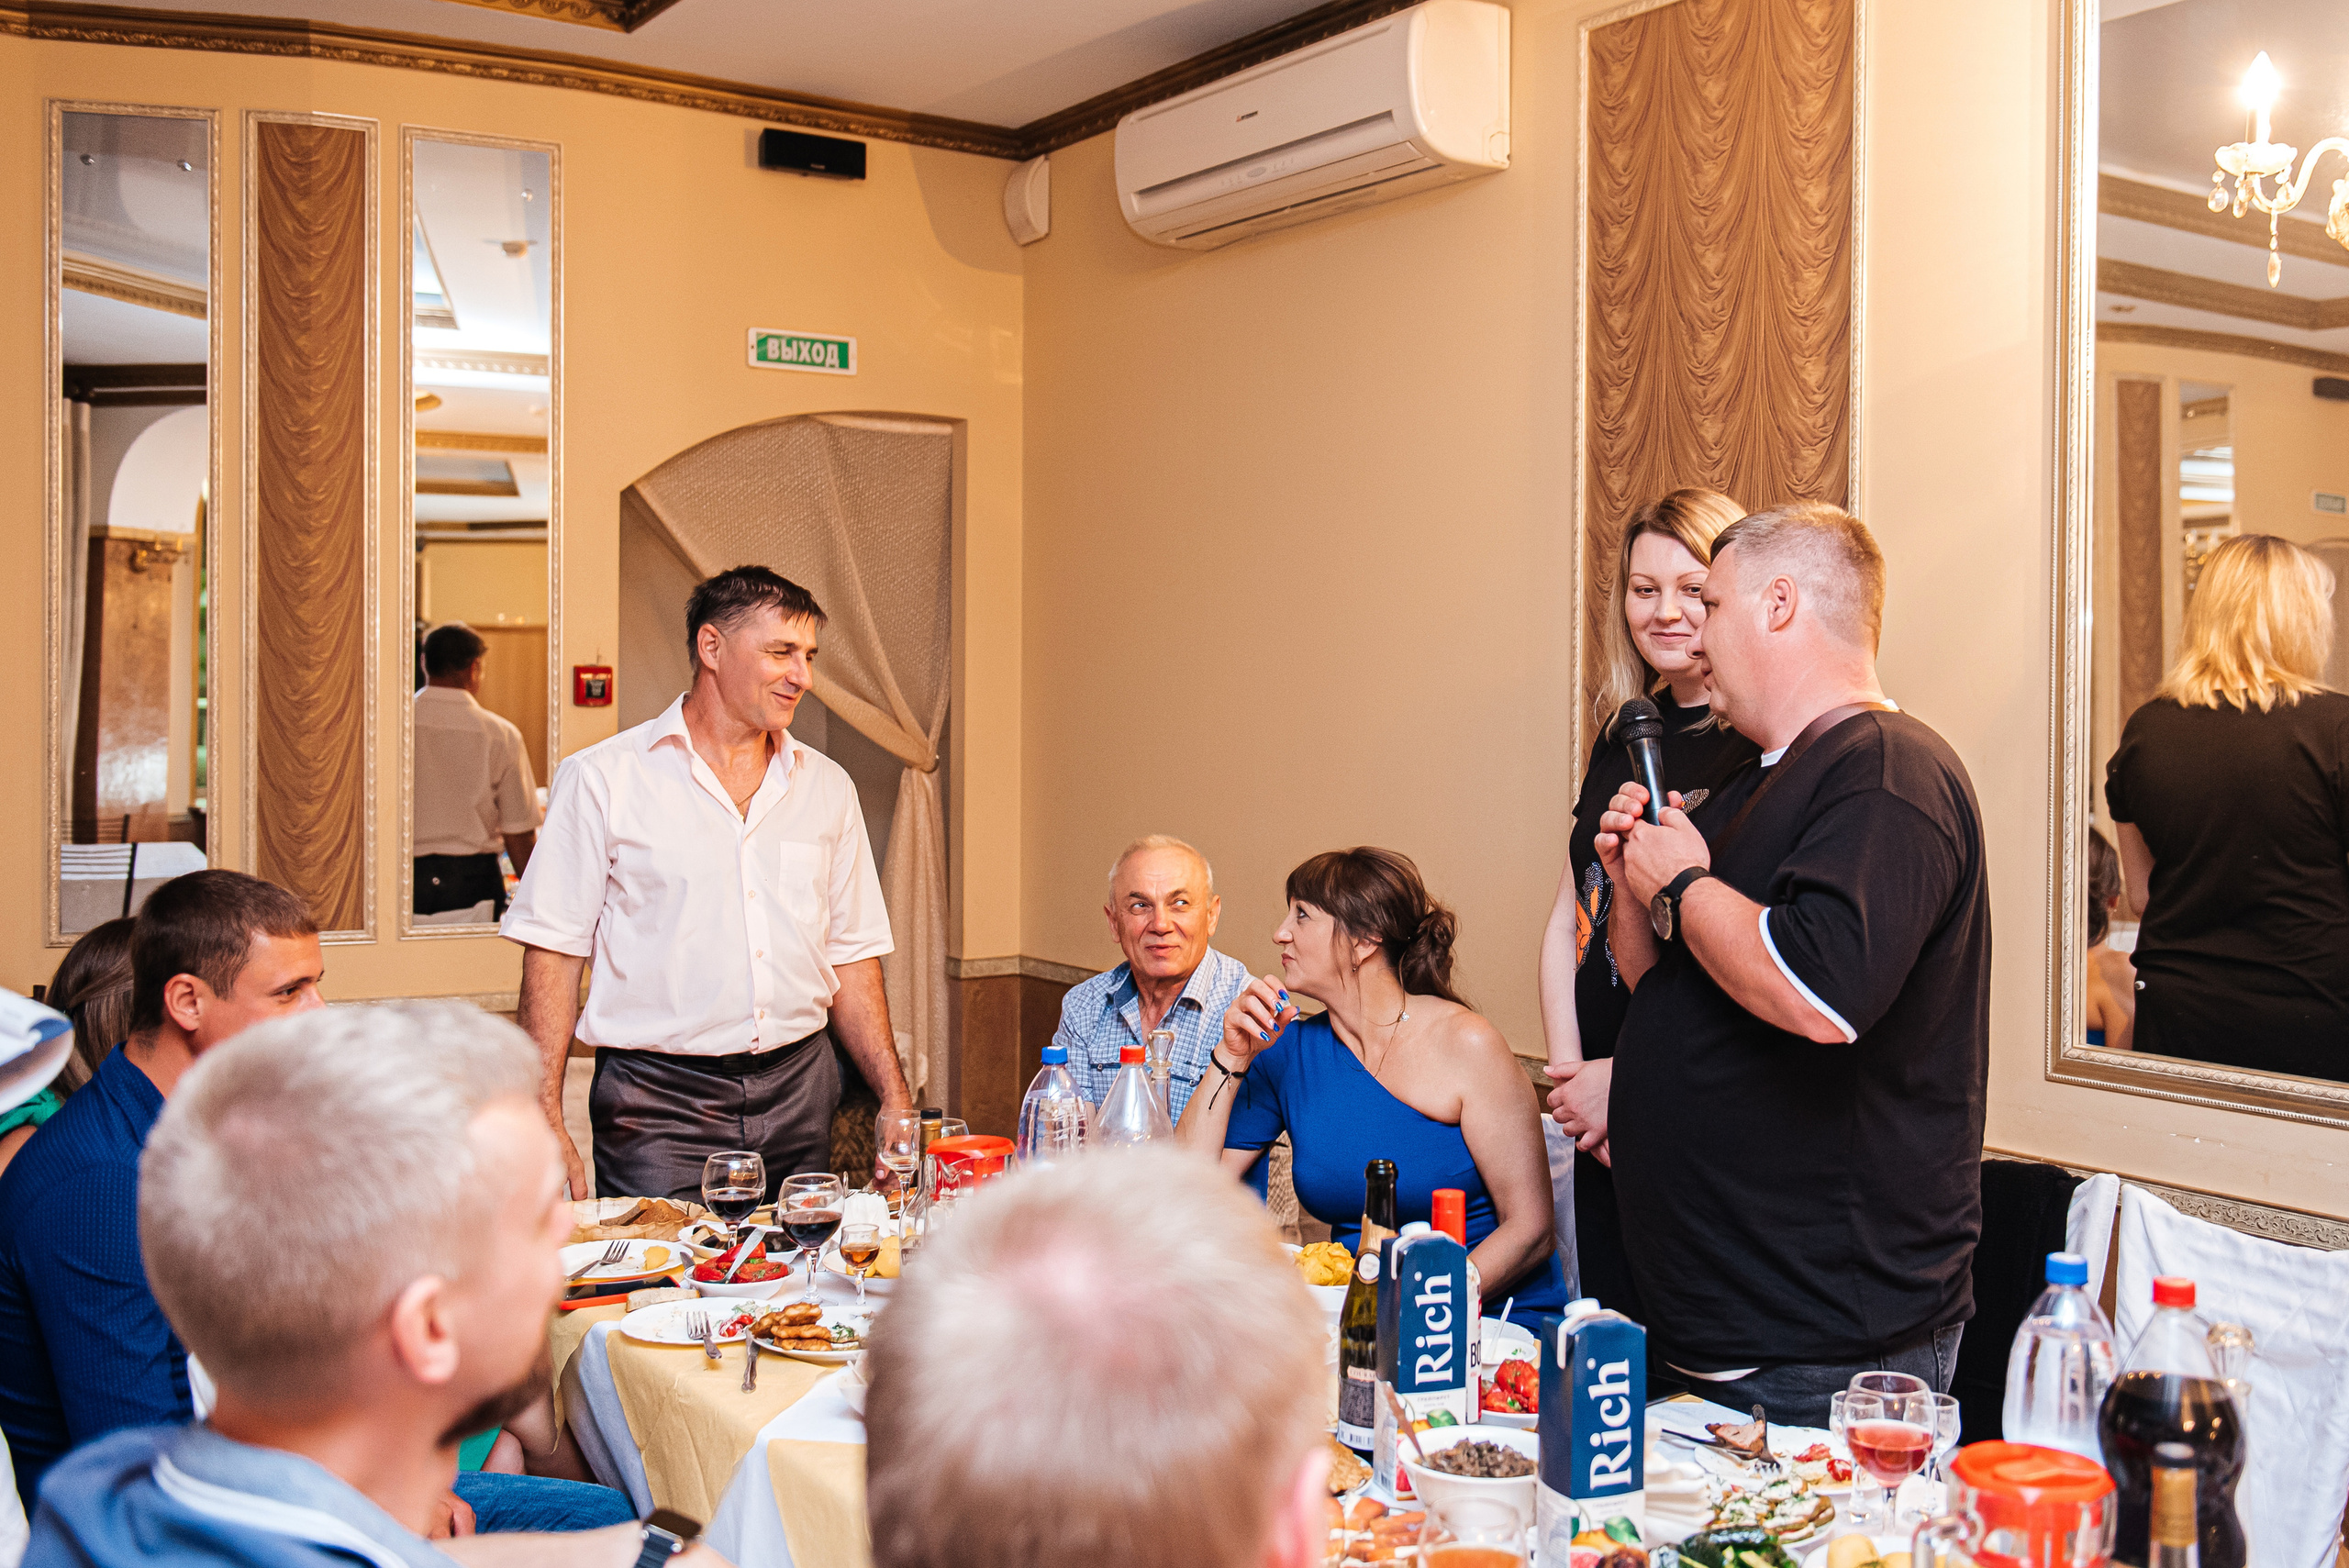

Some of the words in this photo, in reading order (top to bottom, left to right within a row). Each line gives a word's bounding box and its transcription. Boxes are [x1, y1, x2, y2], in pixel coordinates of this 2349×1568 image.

[766, 337, 840, 368] ВЫХОД
[1414, 1272, 1453, 1386] Rich
[1587, 1358, 1632, 1491] Rich
